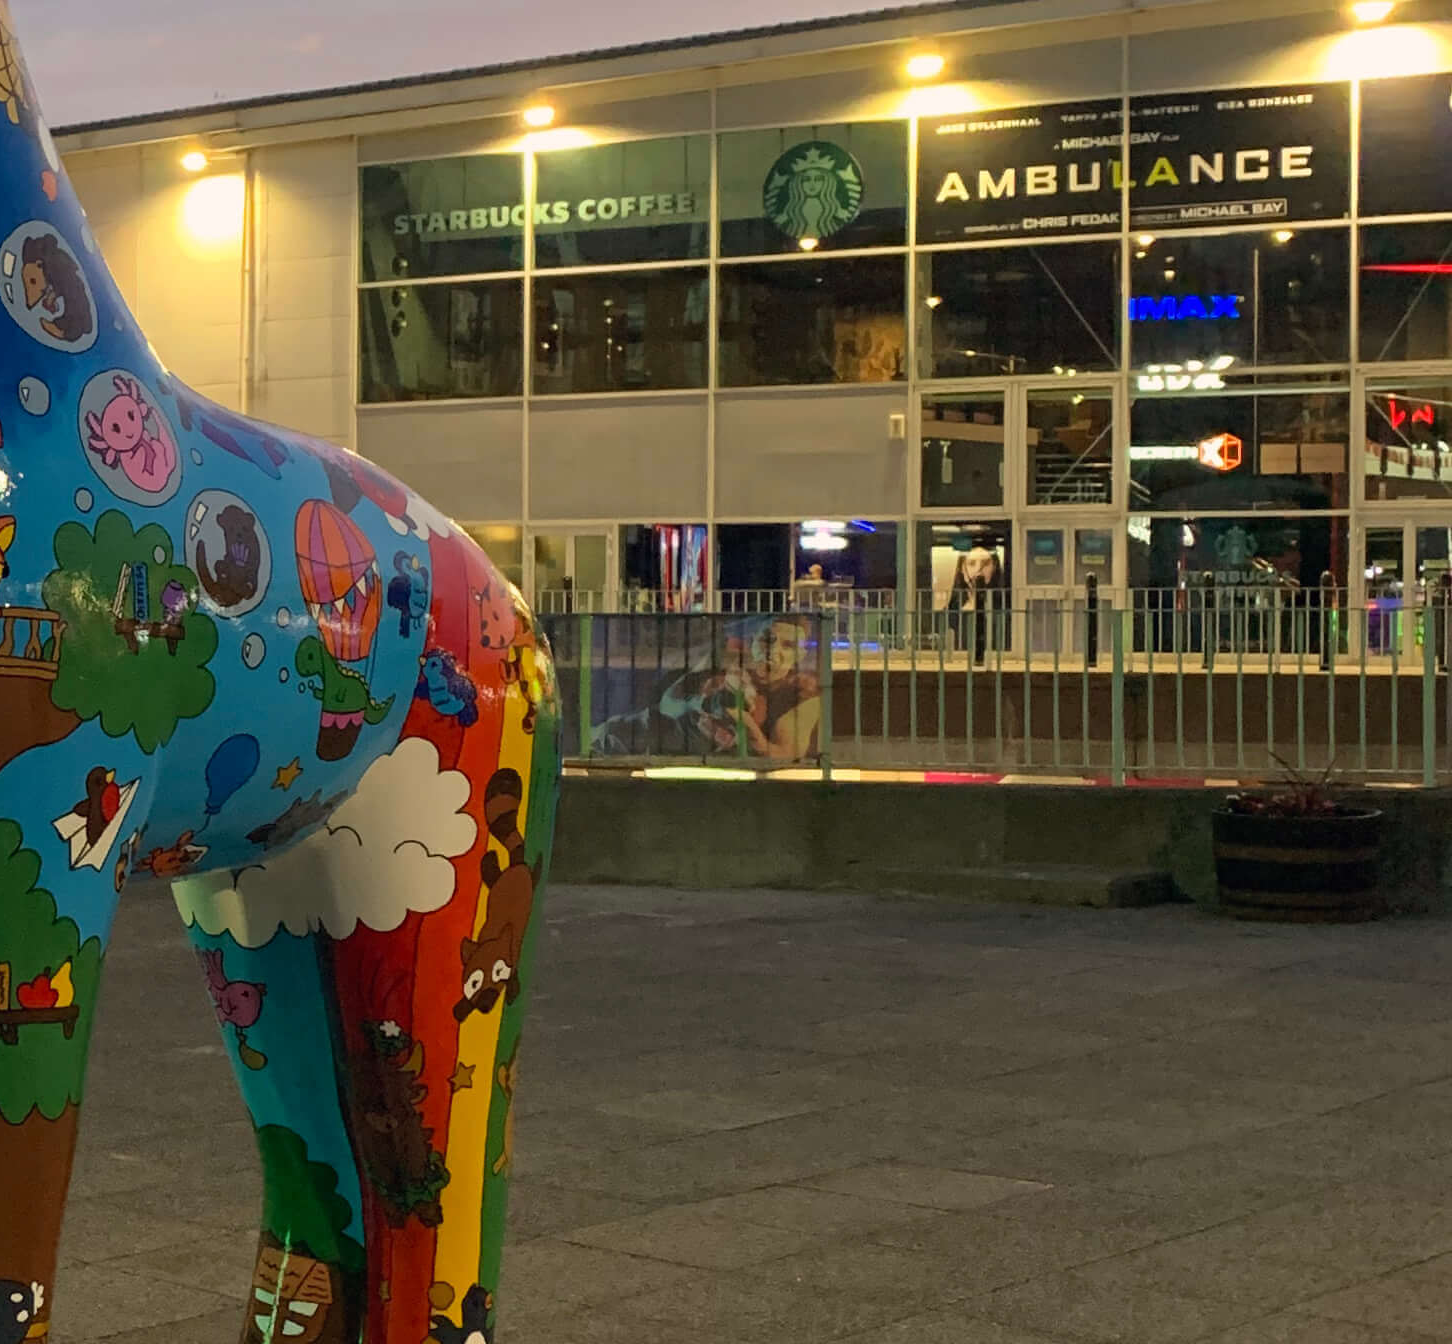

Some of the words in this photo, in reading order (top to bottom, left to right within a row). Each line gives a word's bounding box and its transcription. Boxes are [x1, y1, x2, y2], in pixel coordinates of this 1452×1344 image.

[936, 145, 1313, 202] AMBULANCE
[394, 201, 570, 235] STARBUCKS
[577, 192, 696, 221] COFFEE
[1023, 216, 1068, 229] CHRIS
[1071, 213, 1120, 225] FEDAK
[1180, 206, 1248, 218] MICHAEL
[1252, 203, 1284, 215] BAY
[1128, 295, 1240, 321] IMAX
